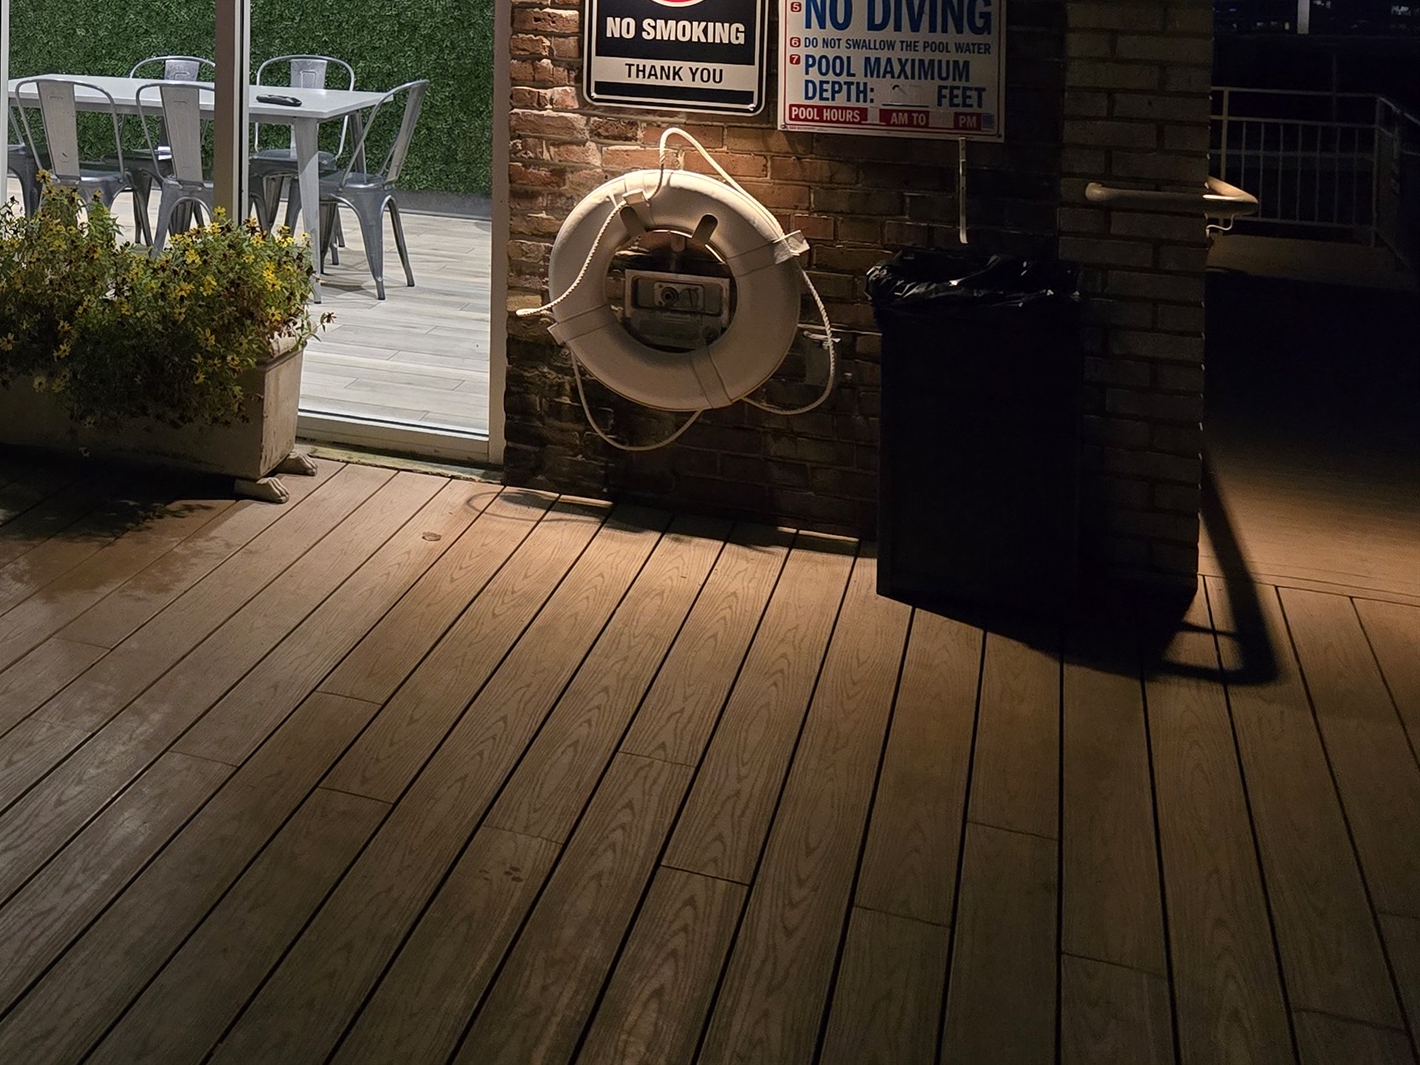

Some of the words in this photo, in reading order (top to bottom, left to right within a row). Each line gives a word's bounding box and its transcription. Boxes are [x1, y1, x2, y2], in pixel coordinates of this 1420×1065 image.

[792, 3, 800, 12] 5
[606, 17, 636, 38] NO
[642, 18, 745, 44] SMOKING
[791, 38, 799, 47] 6
[804, 38, 817, 48] DO
[822, 38, 841, 49] NOT
[845, 39, 896, 51] SWALLOW
[899, 41, 918, 51] THE
[923, 41, 950, 53] POOL
[955, 43, 991, 54] WATER
[625, 63, 683, 82] THANK
[689, 67, 723, 84] YOU
[791, 55, 799, 65] 7
[804, 54, 856, 78] POOL
[863, 56, 970, 82] MAXIMUM
[804, 80, 874, 103] DEPTH:
[937, 85, 986, 108] FEET
[791, 107, 819, 120] POOL
[823, 109, 860, 122] HOURS
[890, 112, 908, 125] AM
[911, 113, 927, 125] TO
[959, 116, 977, 128] PM
